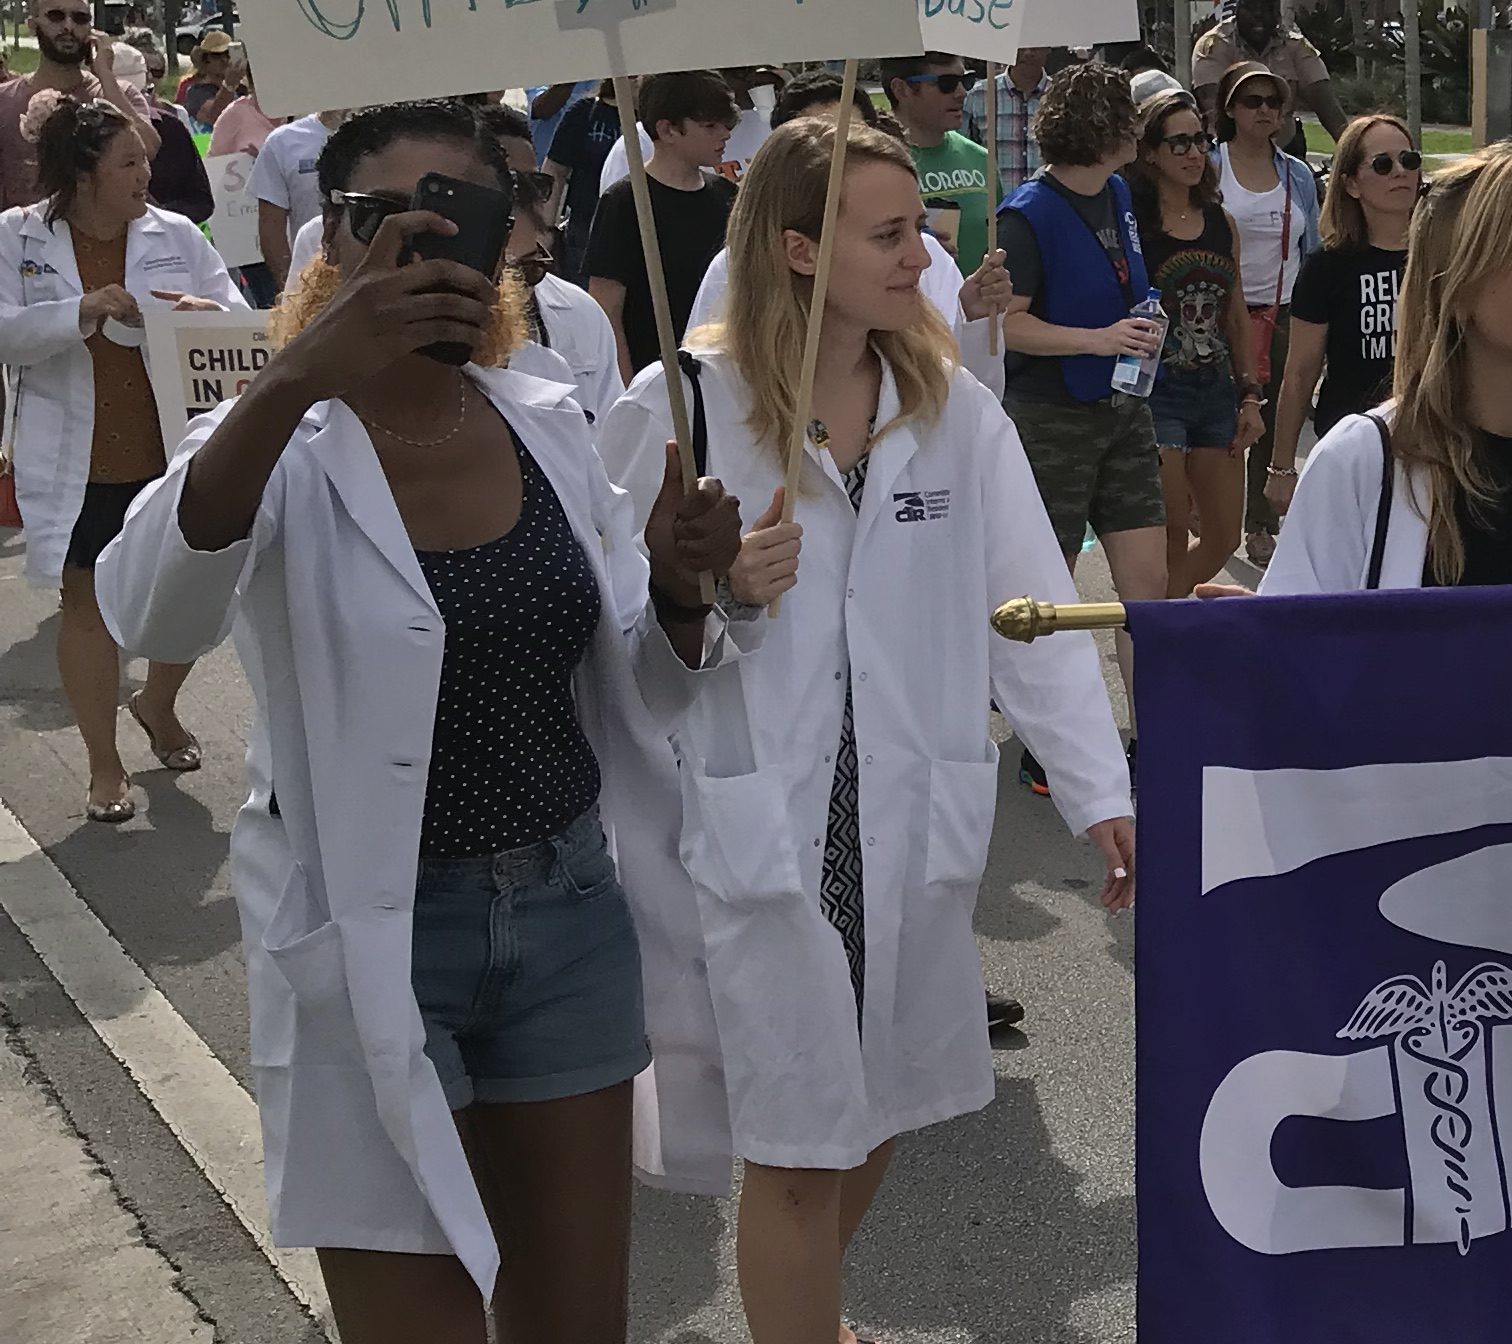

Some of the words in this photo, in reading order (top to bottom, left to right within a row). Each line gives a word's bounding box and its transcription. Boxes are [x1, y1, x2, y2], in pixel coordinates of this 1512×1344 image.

[188, 348, 275, 372] CHILD
[1361, 335, 1386, 360] I'M
[192, 378, 224, 403] IN
